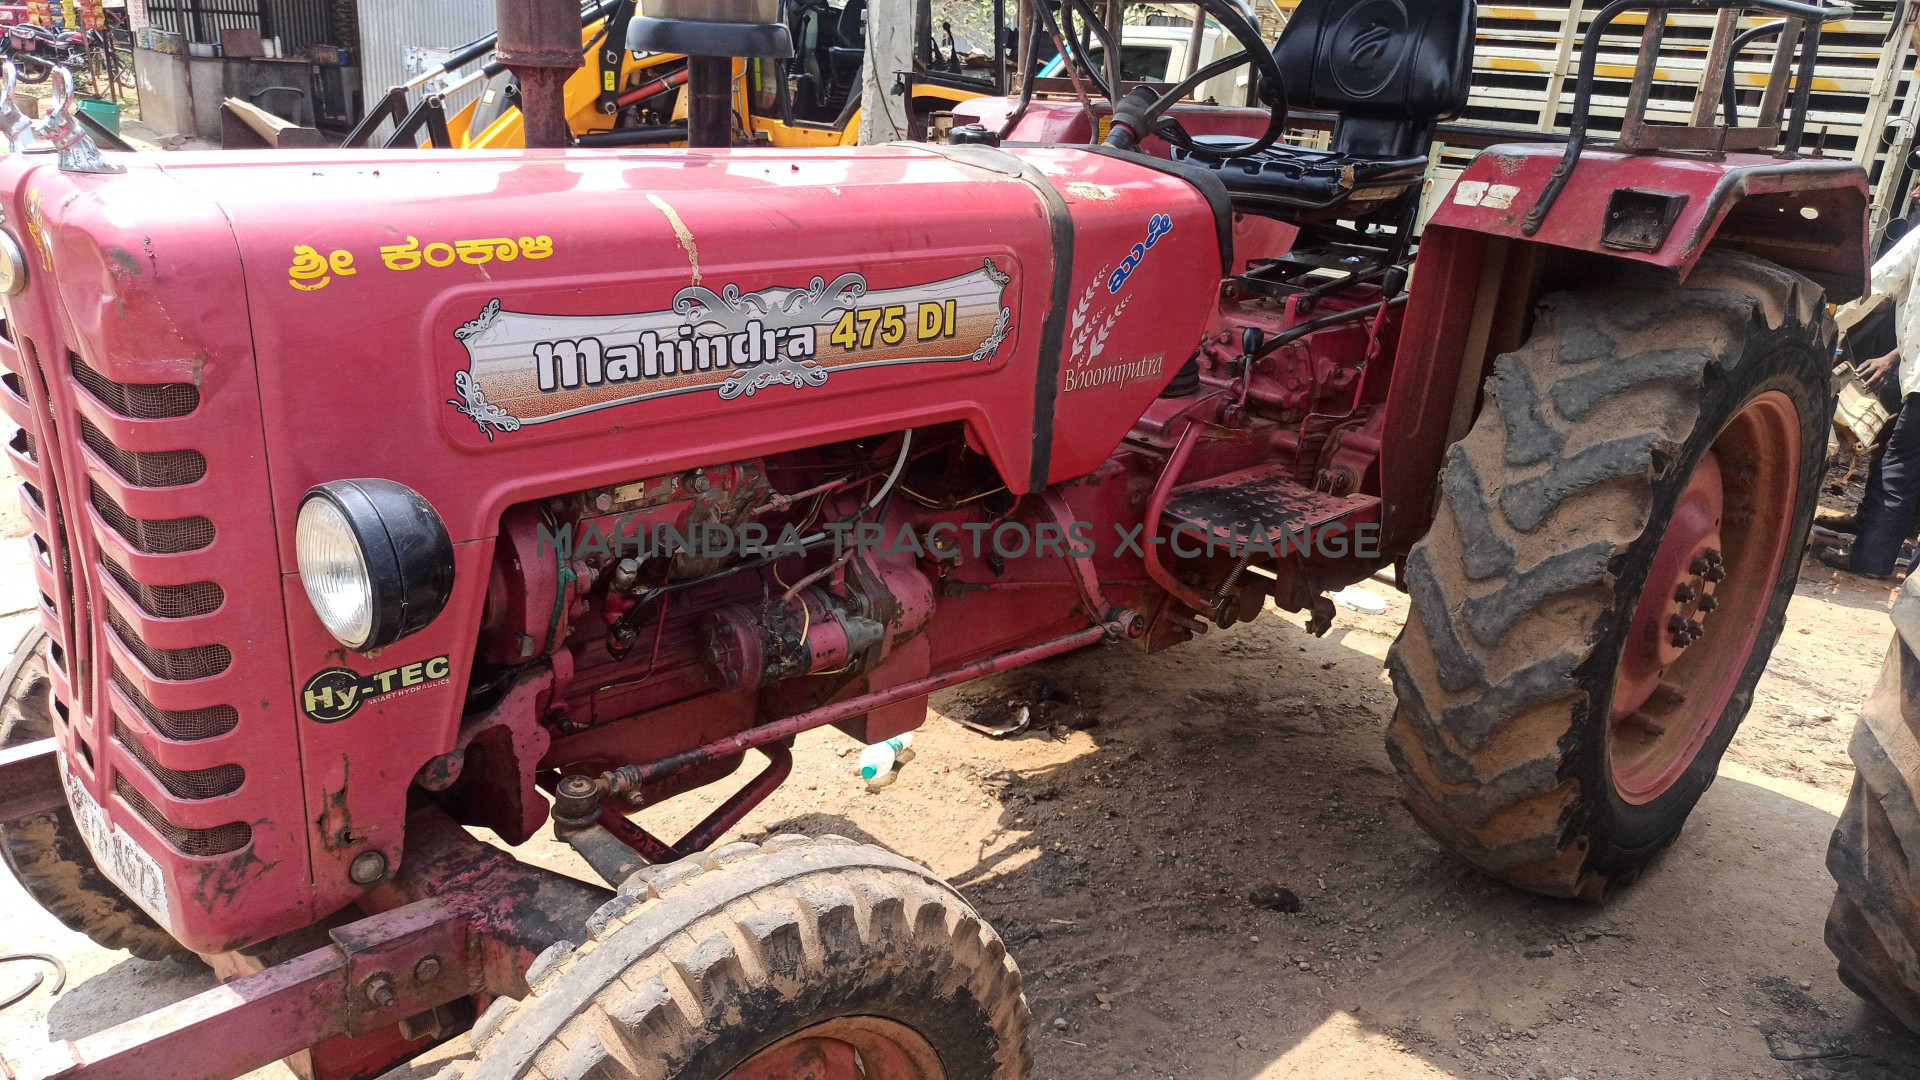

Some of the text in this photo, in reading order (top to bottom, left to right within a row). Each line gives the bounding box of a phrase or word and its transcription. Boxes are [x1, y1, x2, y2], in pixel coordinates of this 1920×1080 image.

[289, 245, 357, 291] ಶ್ರೀ
[533, 300, 955, 394] Mahindra 475 DI
[1064, 355, 1163, 392] Bhoomiputra
[304, 656, 449, 712] Hy-TEC
[398, 678, 450, 697] HYDRAULICS
